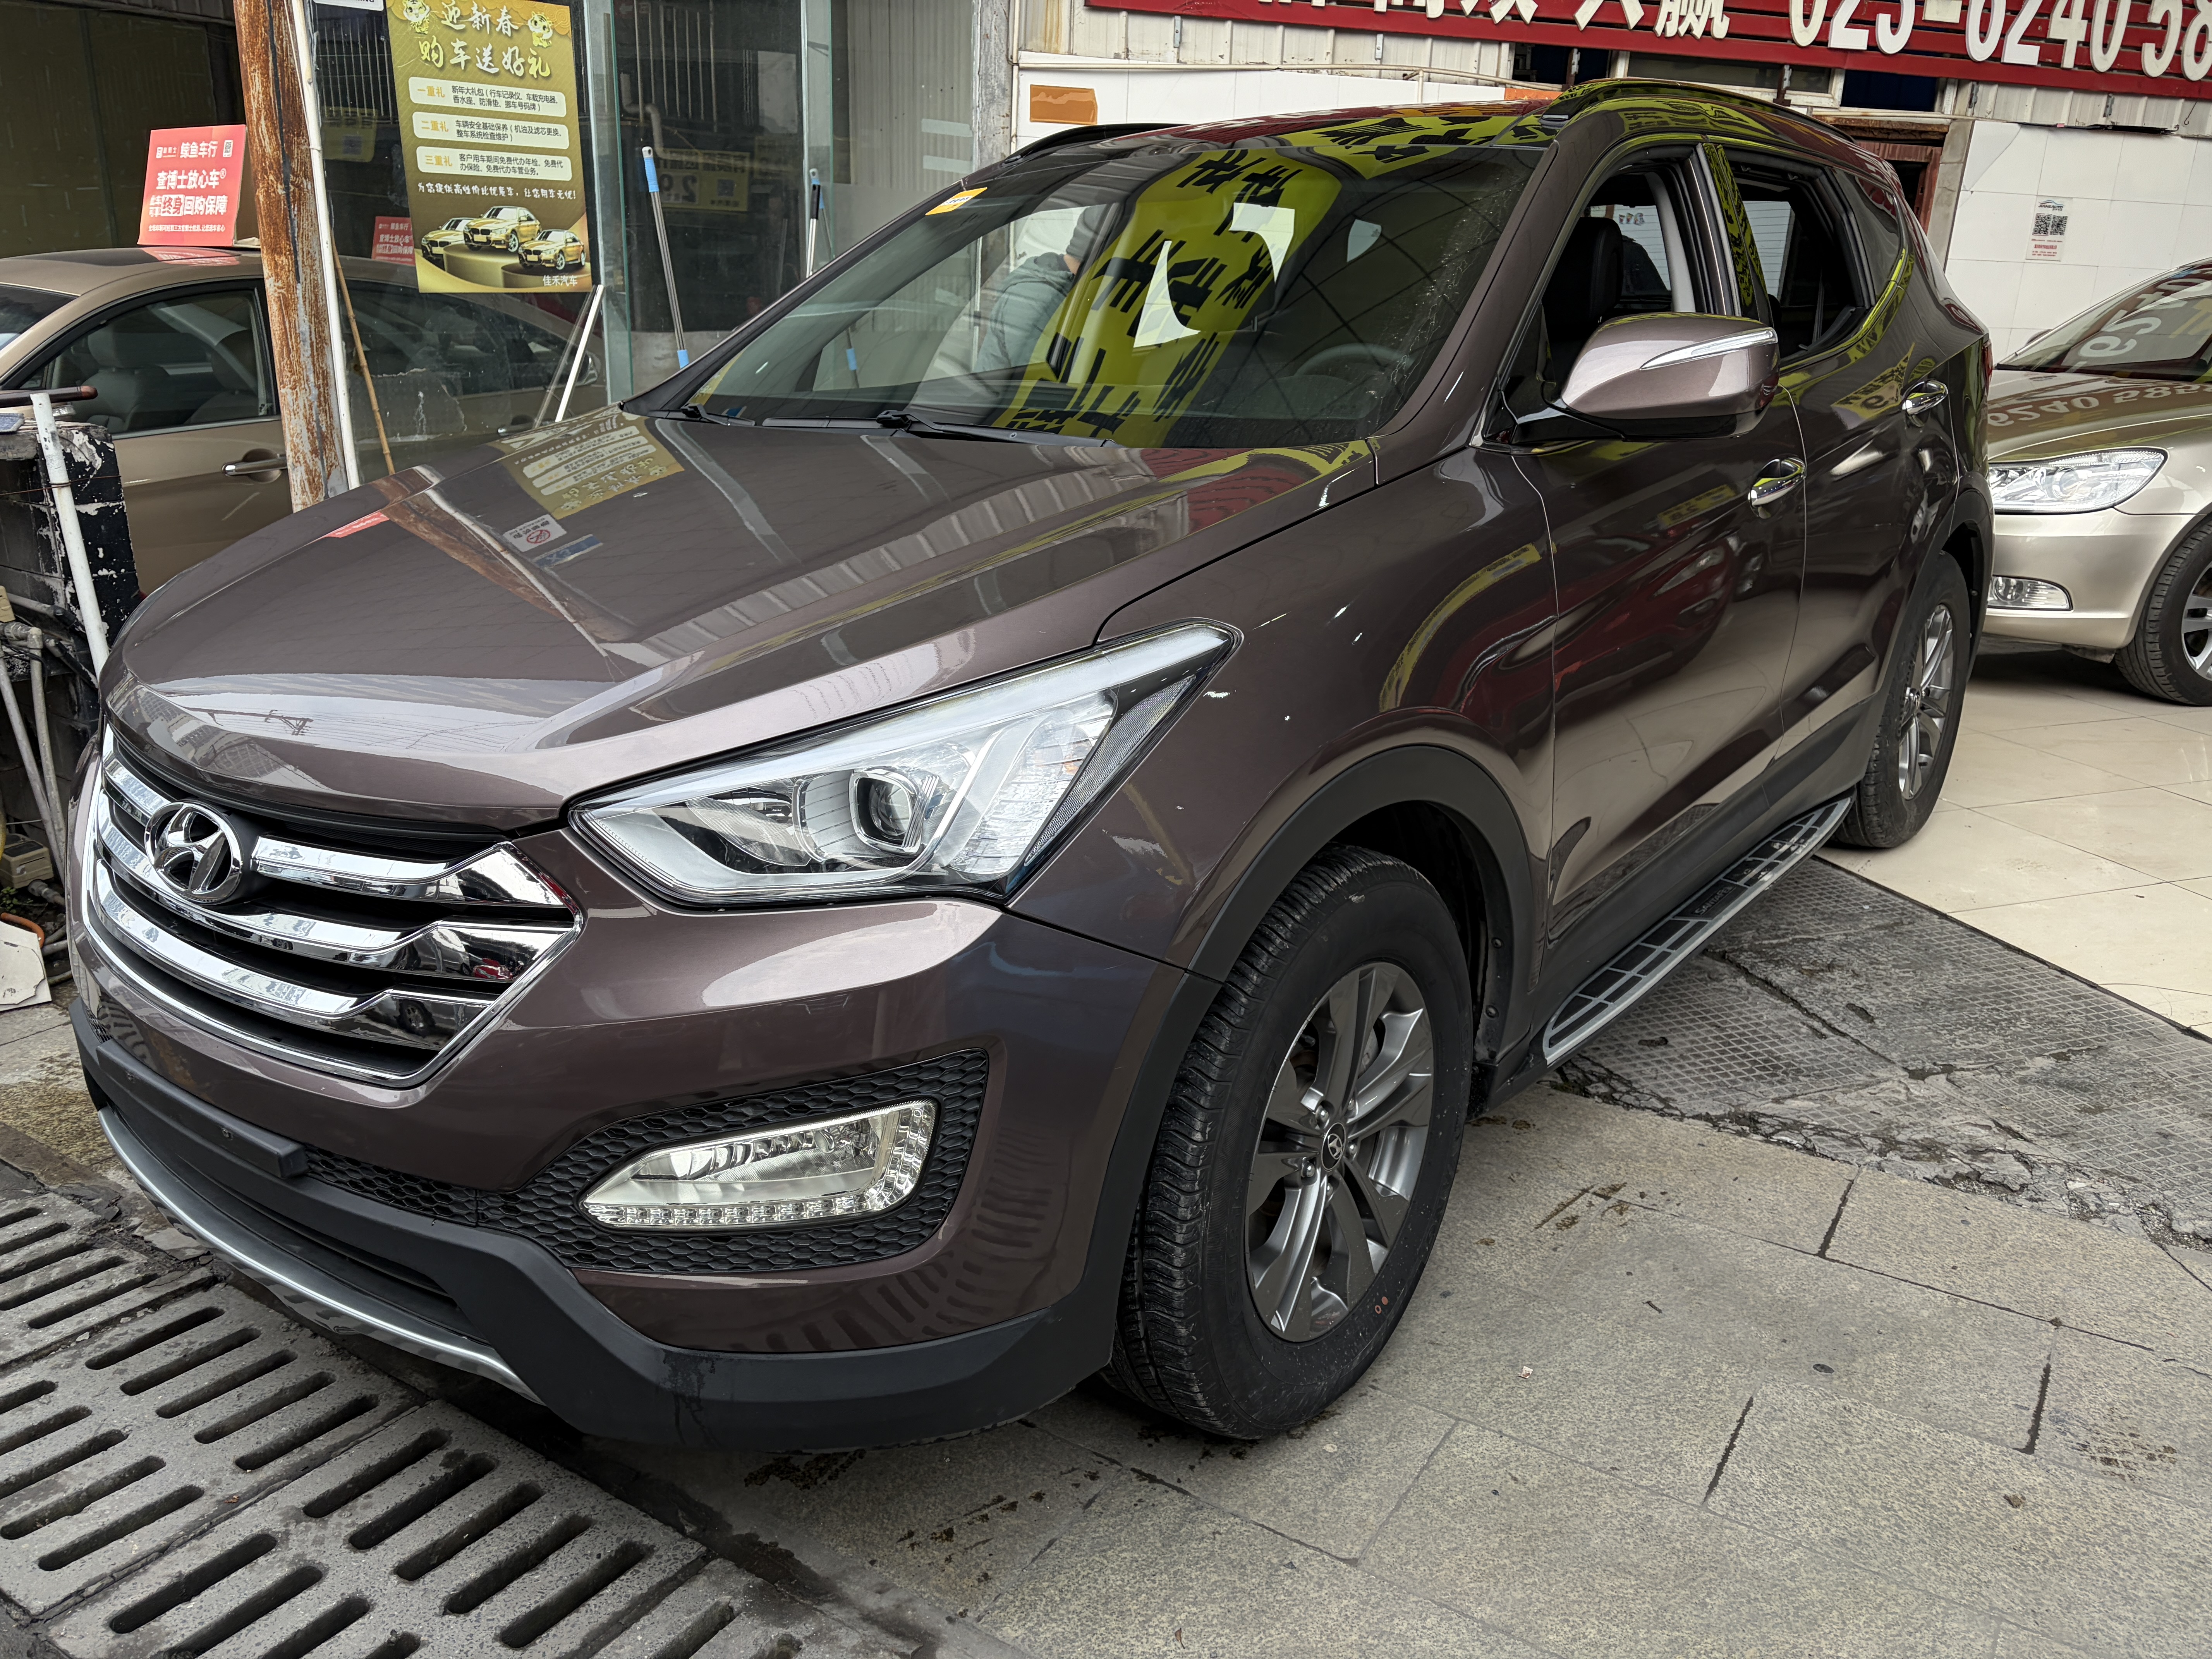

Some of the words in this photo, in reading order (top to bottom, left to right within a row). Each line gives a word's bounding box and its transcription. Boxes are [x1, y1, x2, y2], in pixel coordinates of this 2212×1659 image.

[441, 0, 519, 37] 迎新春
[419, 35, 550, 78] 购车送好礼
[417, 86, 445, 98] 一重礼
[421, 120, 449, 132] 二重礼
[425, 155, 453, 167] 三重礼
[543, 275, 578, 287] 佳禾汽车
